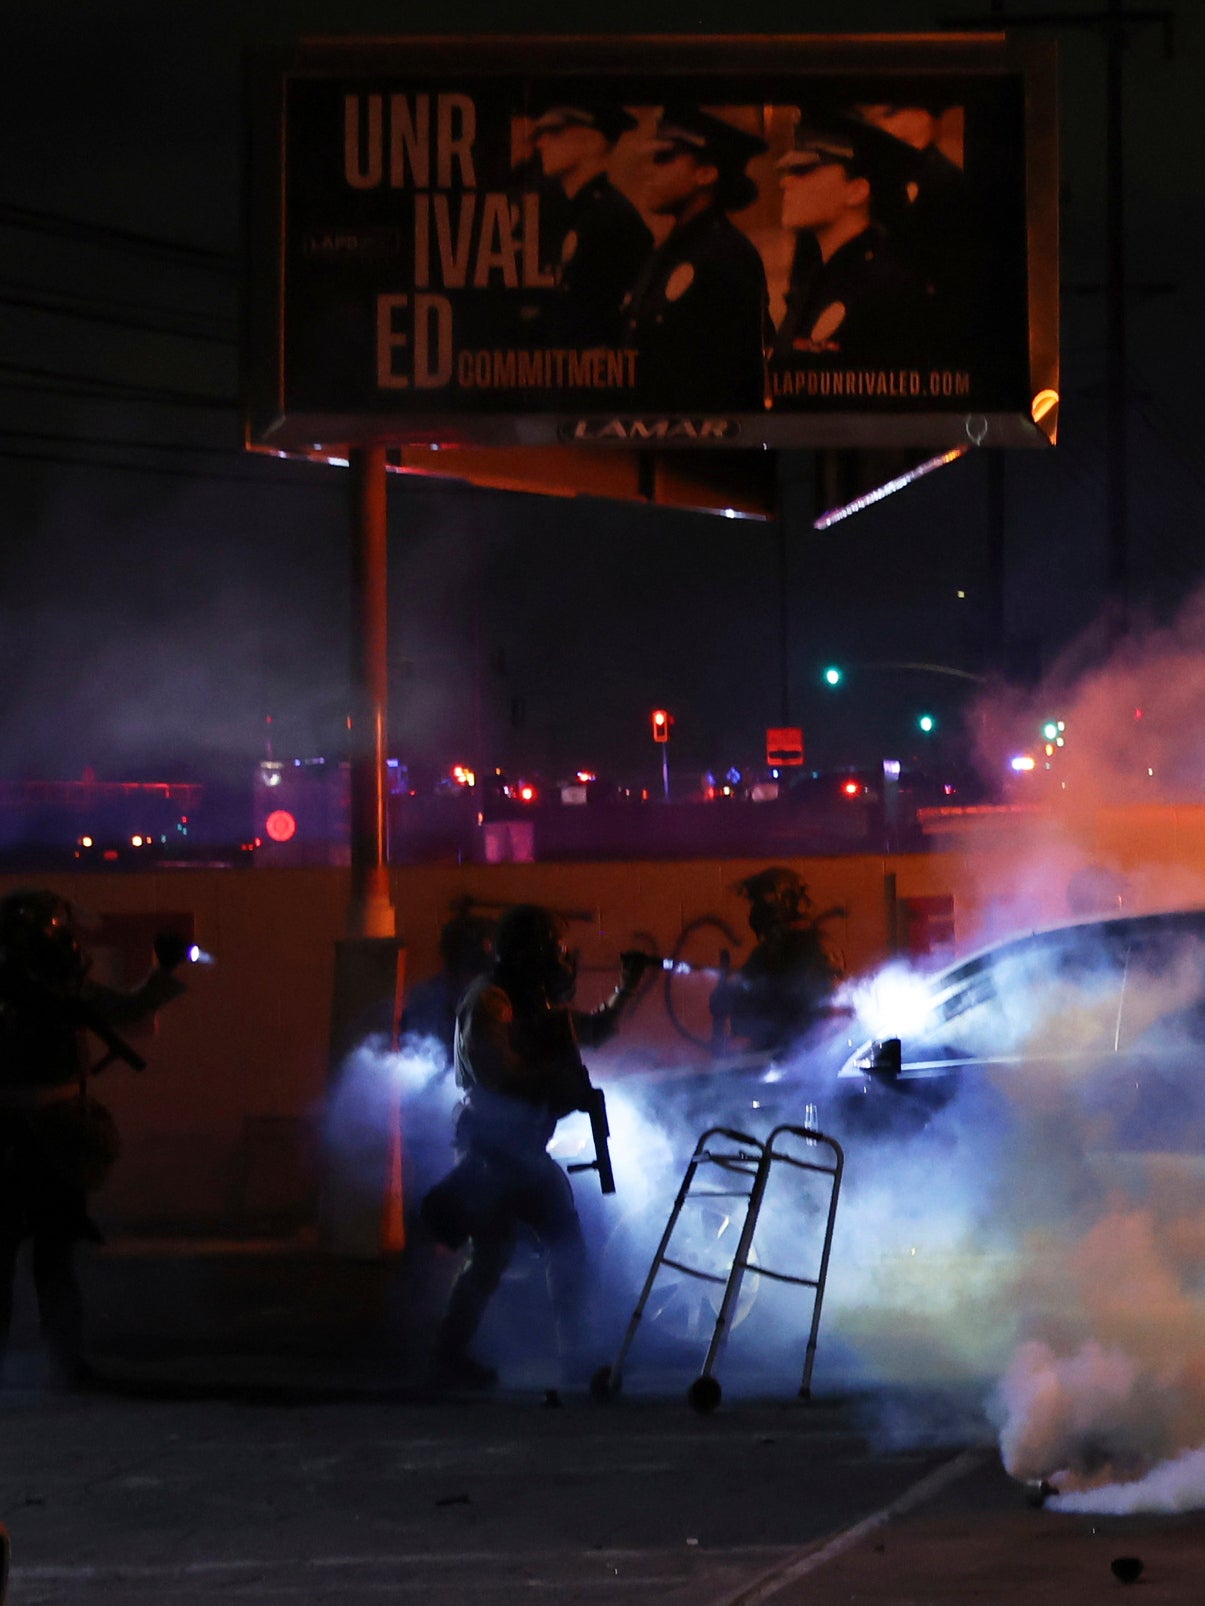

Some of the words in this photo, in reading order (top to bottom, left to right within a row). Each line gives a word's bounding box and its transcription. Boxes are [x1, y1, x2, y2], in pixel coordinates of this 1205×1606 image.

[343, 92, 477, 190] UNR
[413, 192, 555, 289] IVAL
[376, 292, 454, 389] ED
[458, 348, 639, 388] COMMITMENT
[773, 369, 971, 396] LAPDUNRIVALED.COM
[574, 419, 729, 438] LAMAR
